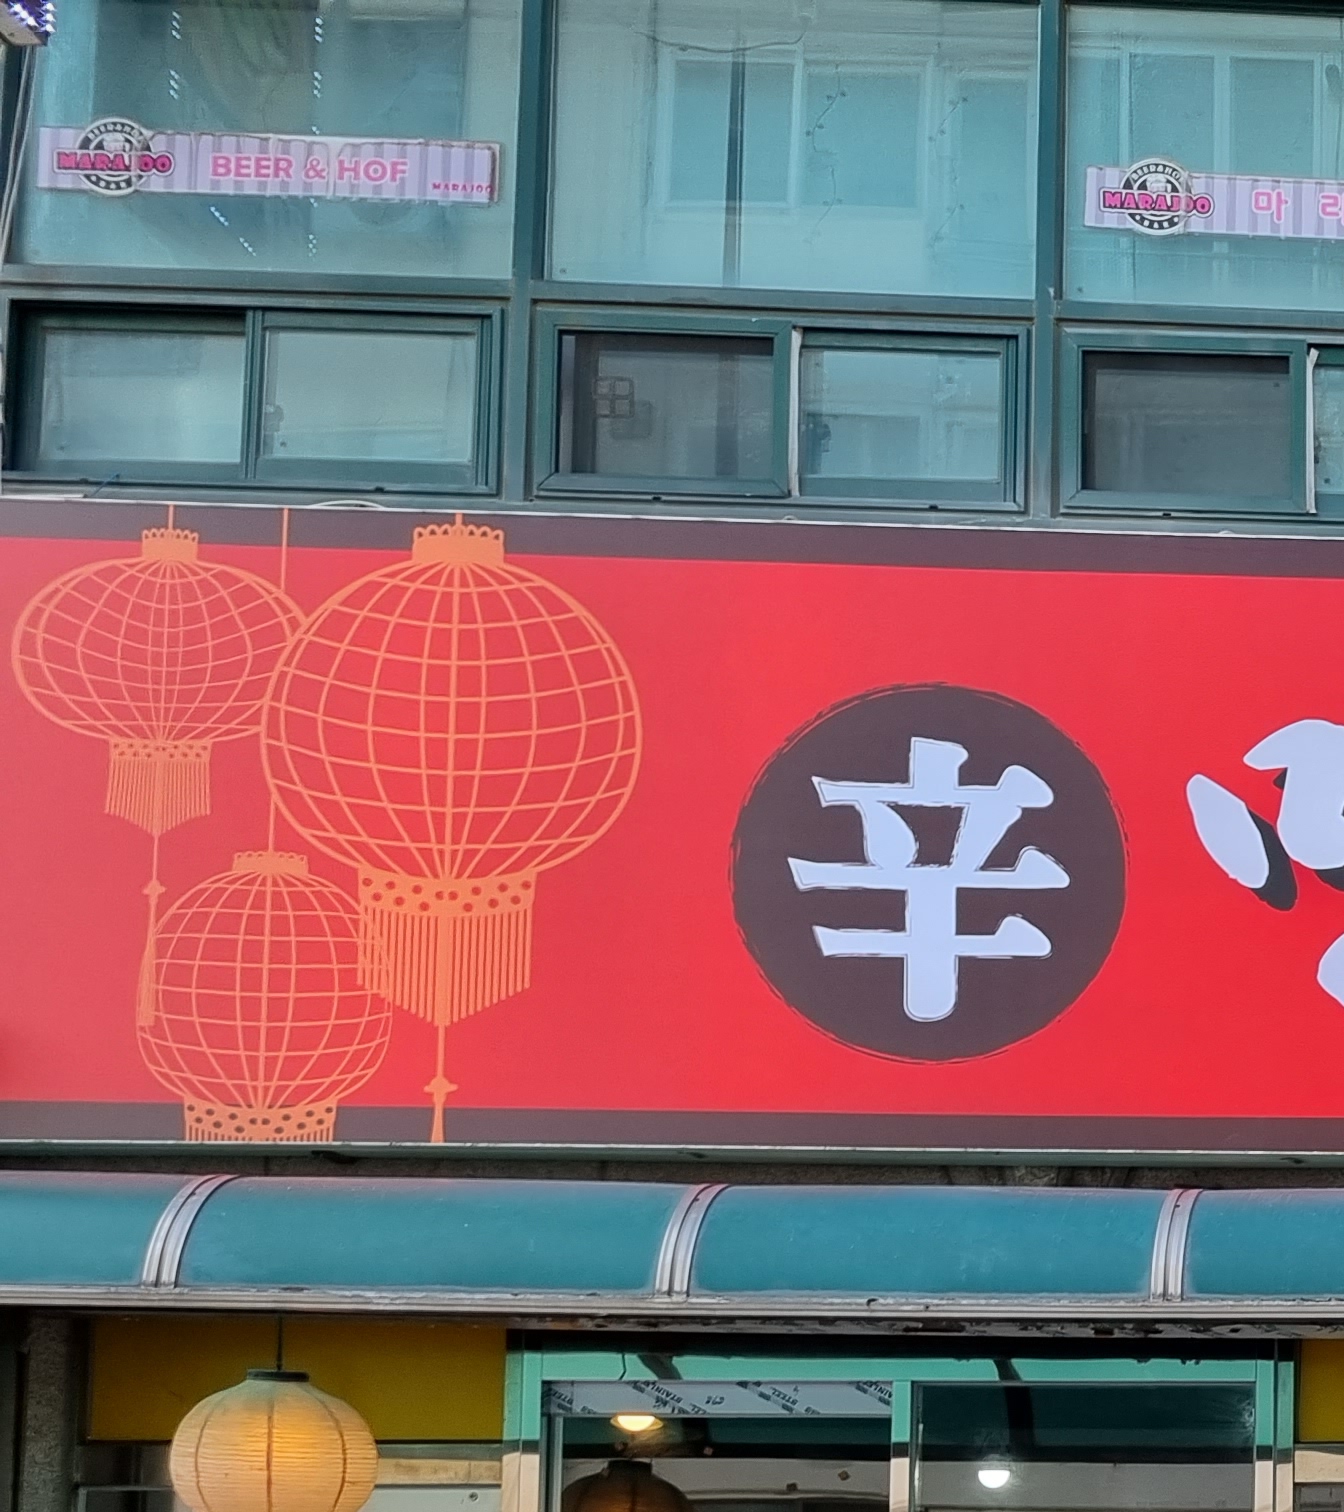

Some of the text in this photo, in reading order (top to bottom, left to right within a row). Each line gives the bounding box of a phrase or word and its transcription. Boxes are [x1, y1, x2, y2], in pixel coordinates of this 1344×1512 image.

[57, 152, 173, 174] MARAOO
[211, 154, 408, 182] BEER & HOF
[786, 736, 1073, 1023] 辛
